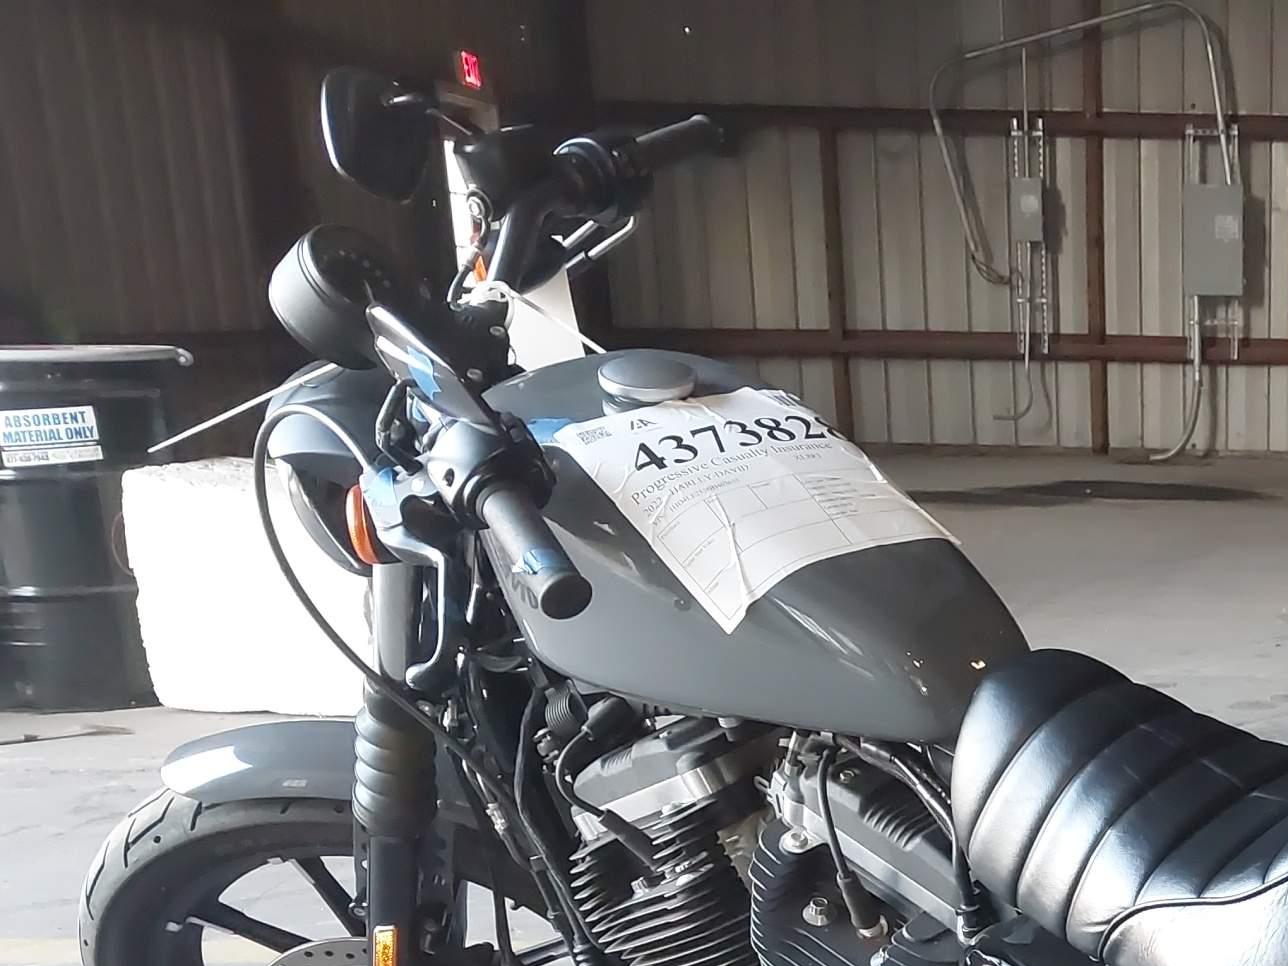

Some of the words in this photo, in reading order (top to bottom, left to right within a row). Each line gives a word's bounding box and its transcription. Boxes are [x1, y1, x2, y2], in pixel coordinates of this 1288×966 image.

[4, 411, 87, 428] ABSORBENT
[3, 428, 63, 444] MATERIAL
[65, 426, 95, 440] ONLY
[630, 461, 709, 505] Progressive
[710, 445, 769, 467] Casualty
[770, 441, 833, 455] Insurance
